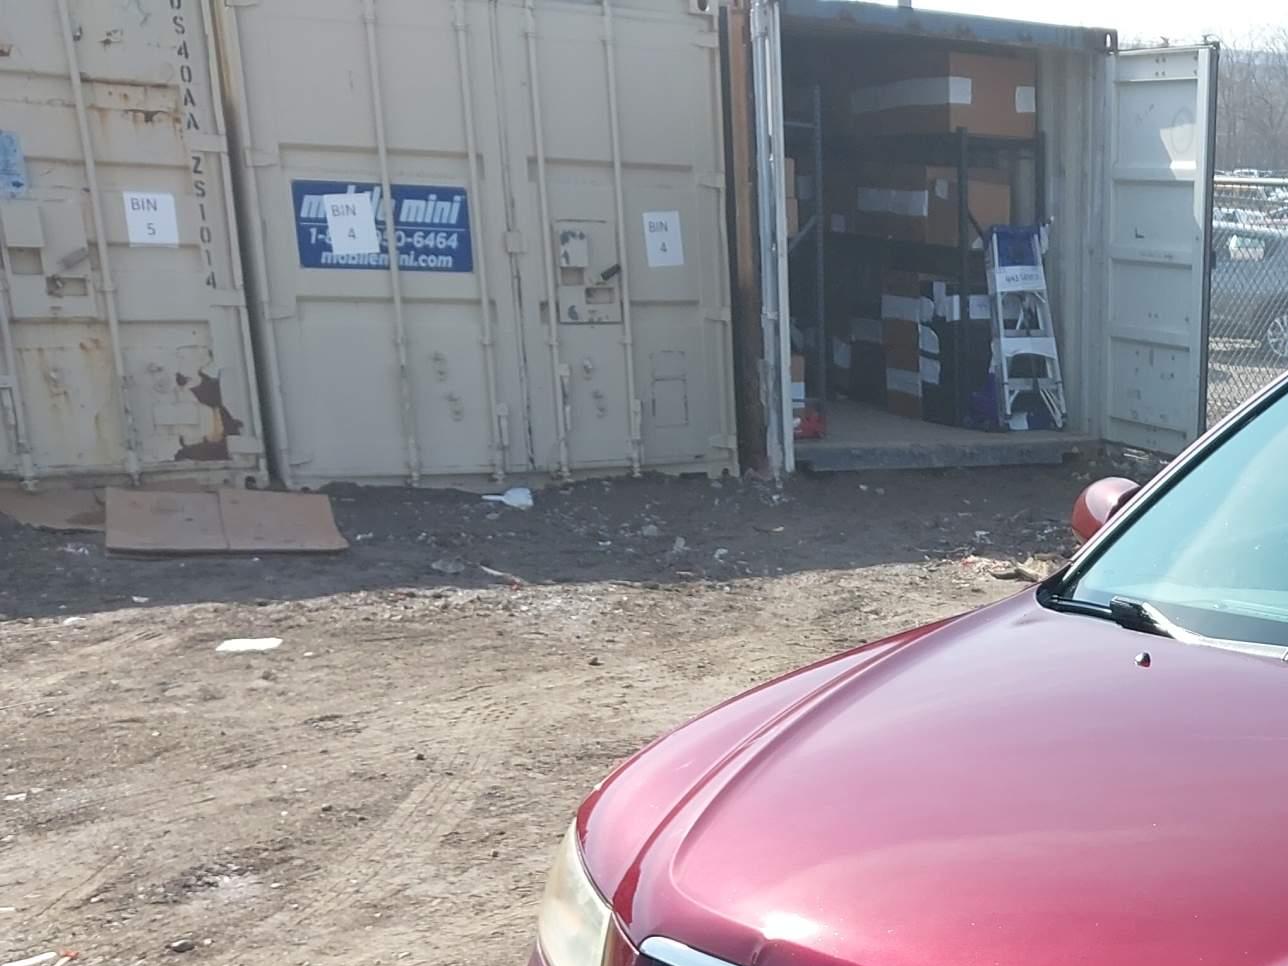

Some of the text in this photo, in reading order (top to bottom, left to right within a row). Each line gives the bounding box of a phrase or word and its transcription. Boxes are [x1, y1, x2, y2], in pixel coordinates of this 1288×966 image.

[130, 197, 158, 212] BIN
[331, 203, 357, 218] BIN
[400, 194, 463, 224] mini
[146, 222, 156, 236] 5
